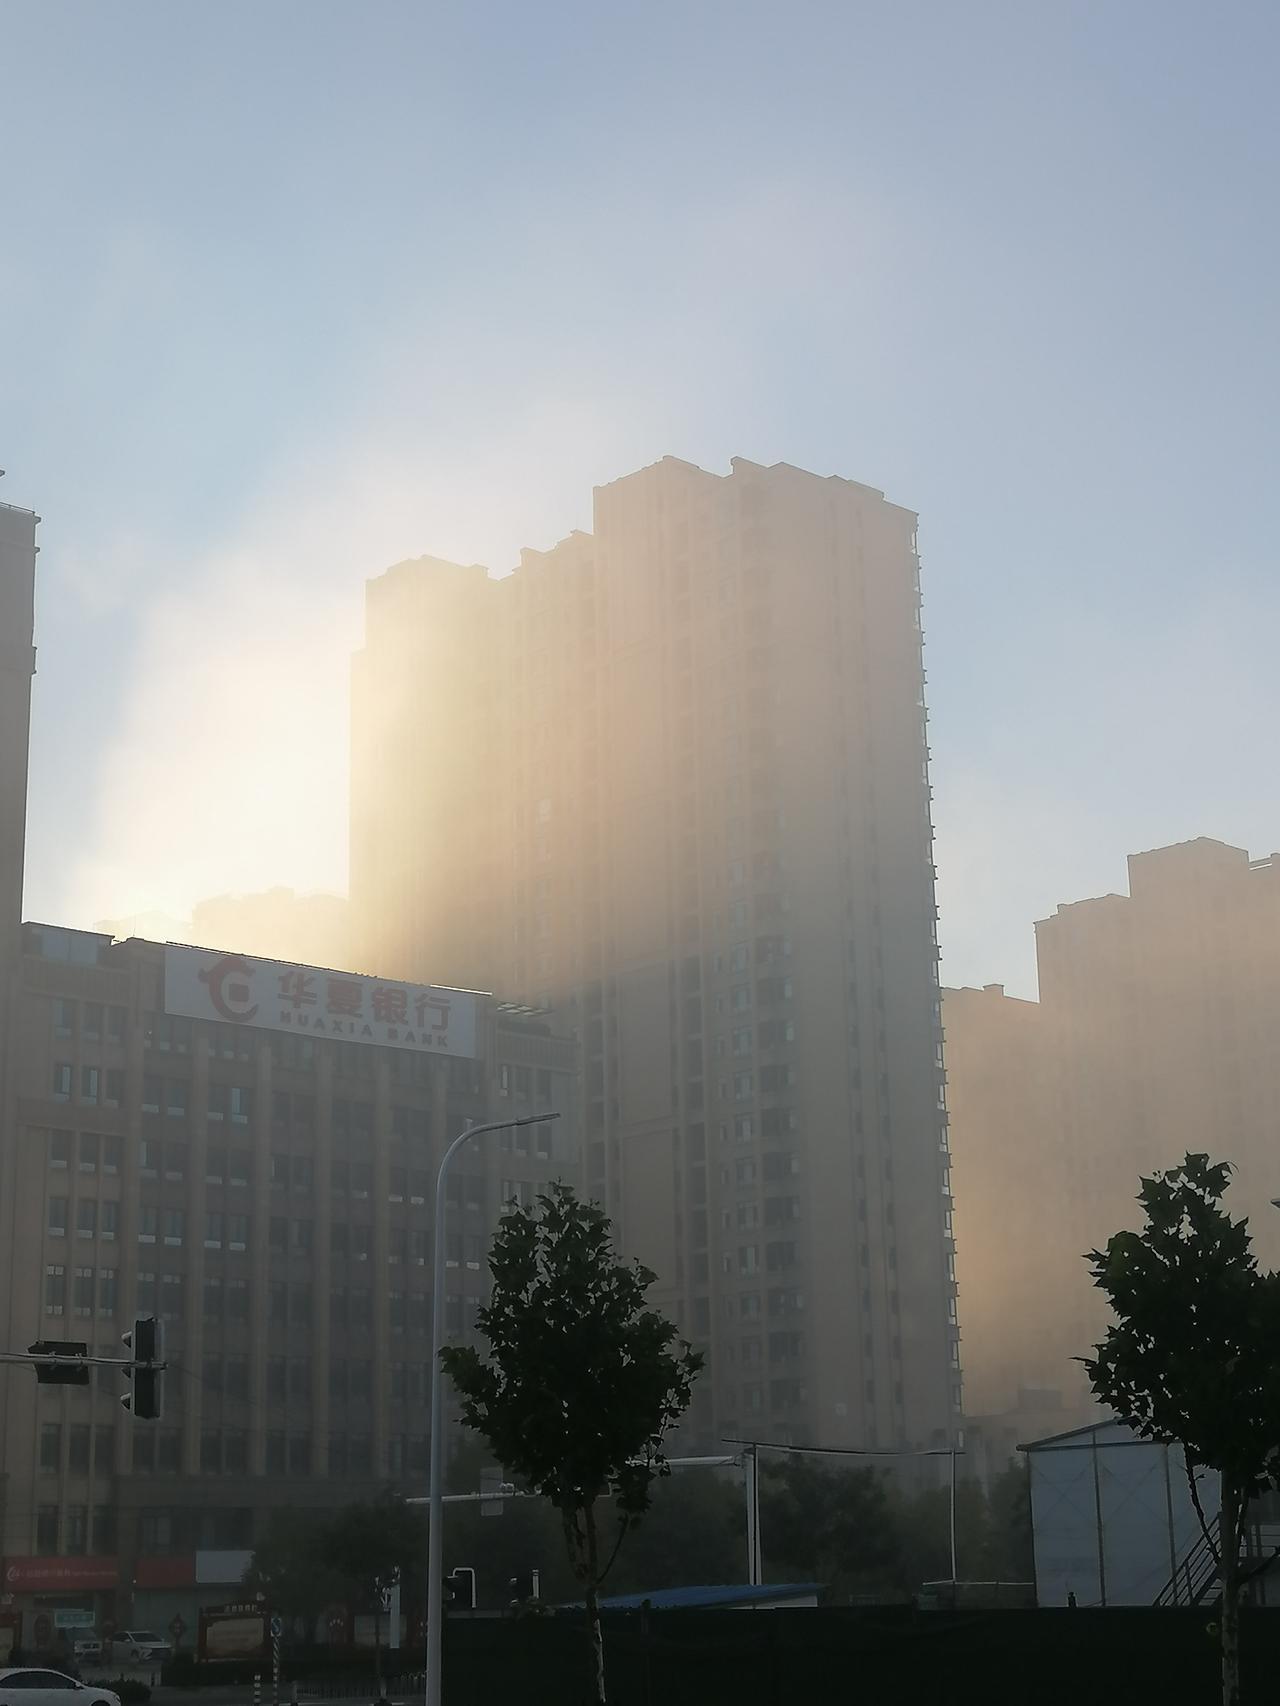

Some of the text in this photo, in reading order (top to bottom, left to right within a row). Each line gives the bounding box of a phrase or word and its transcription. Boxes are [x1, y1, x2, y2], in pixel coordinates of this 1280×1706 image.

[277, 970, 450, 1031] 华夏银行
[279, 1010, 449, 1048] HUAXIA BANK
